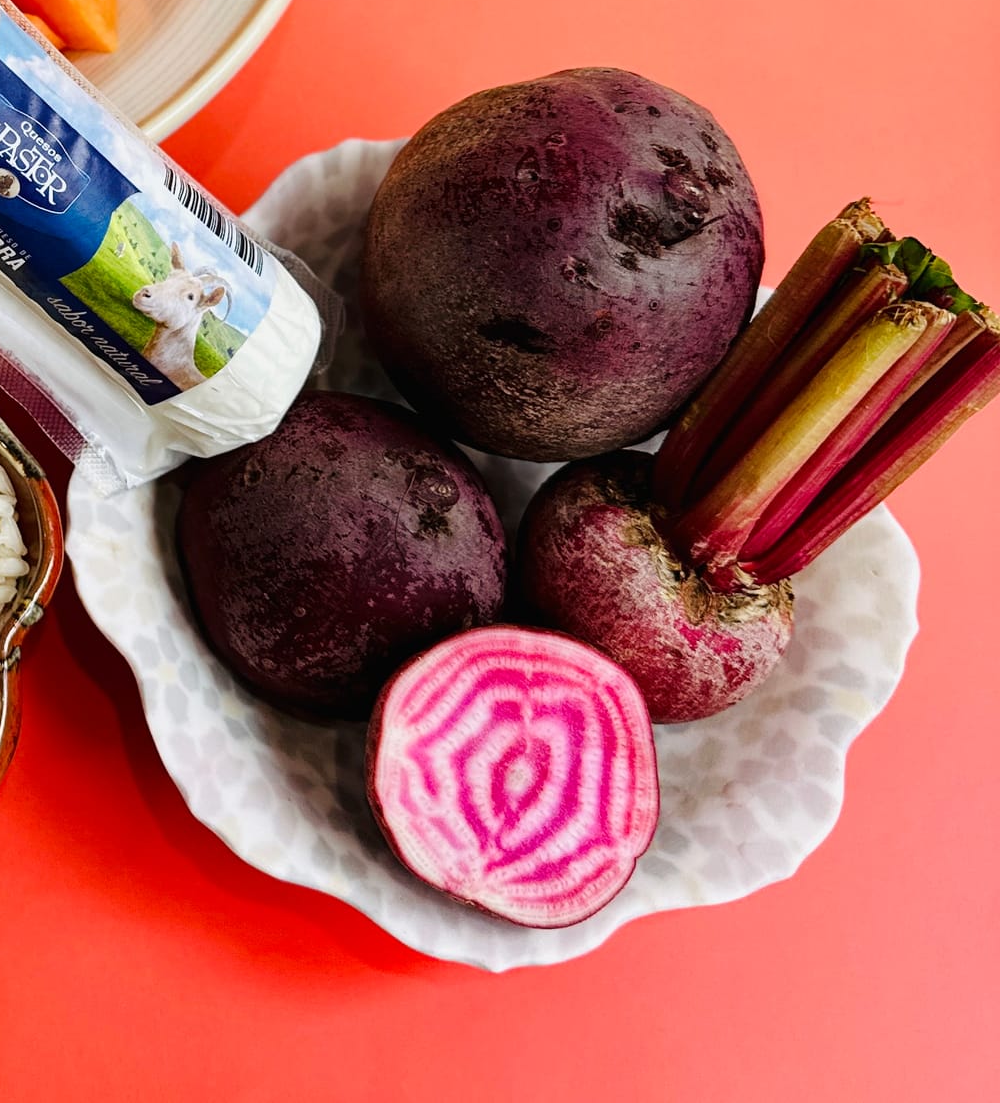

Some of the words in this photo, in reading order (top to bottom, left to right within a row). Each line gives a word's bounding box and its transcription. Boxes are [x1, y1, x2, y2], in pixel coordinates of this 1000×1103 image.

[20, 120, 62, 163] Quesos
[19, 249, 32, 260] DE
[46, 297, 95, 335] sabor
[90, 336, 163, 386] natural
